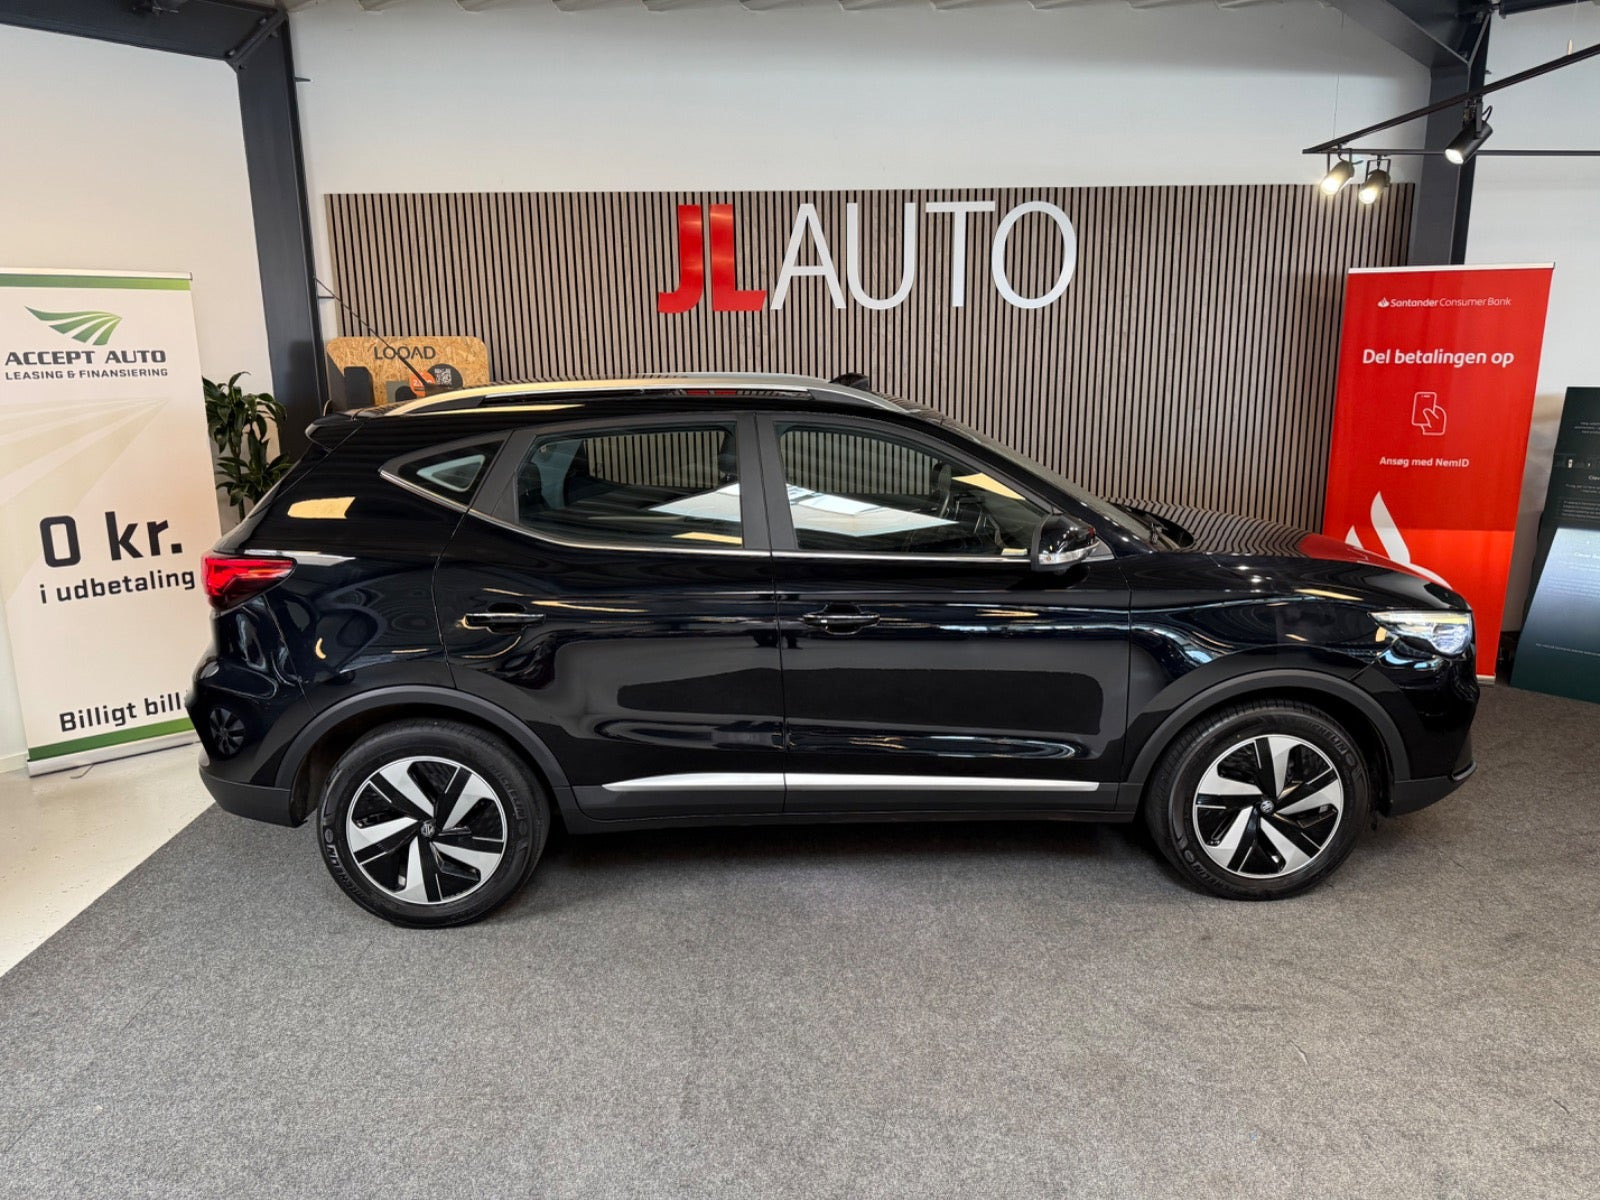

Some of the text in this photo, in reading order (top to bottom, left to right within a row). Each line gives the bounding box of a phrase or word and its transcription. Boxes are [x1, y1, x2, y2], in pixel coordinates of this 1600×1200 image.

[770, 200, 1078, 310] AUTO
[1390, 296, 1512, 308] Santander Consumer Bank
[5, 350, 166, 366] ACCEPT AUTO
[1362, 349, 1514, 368] Del betalingen op
[5, 368, 168, 381] LEASING & FINANSIERING
[1379, 456, 1470, 468] Ansøg med NemID
[105, 511, 183, 561] kr.
[39, 569, 196, 604] i udbetaling
[59, 692, 182, 733] Billigt bill
